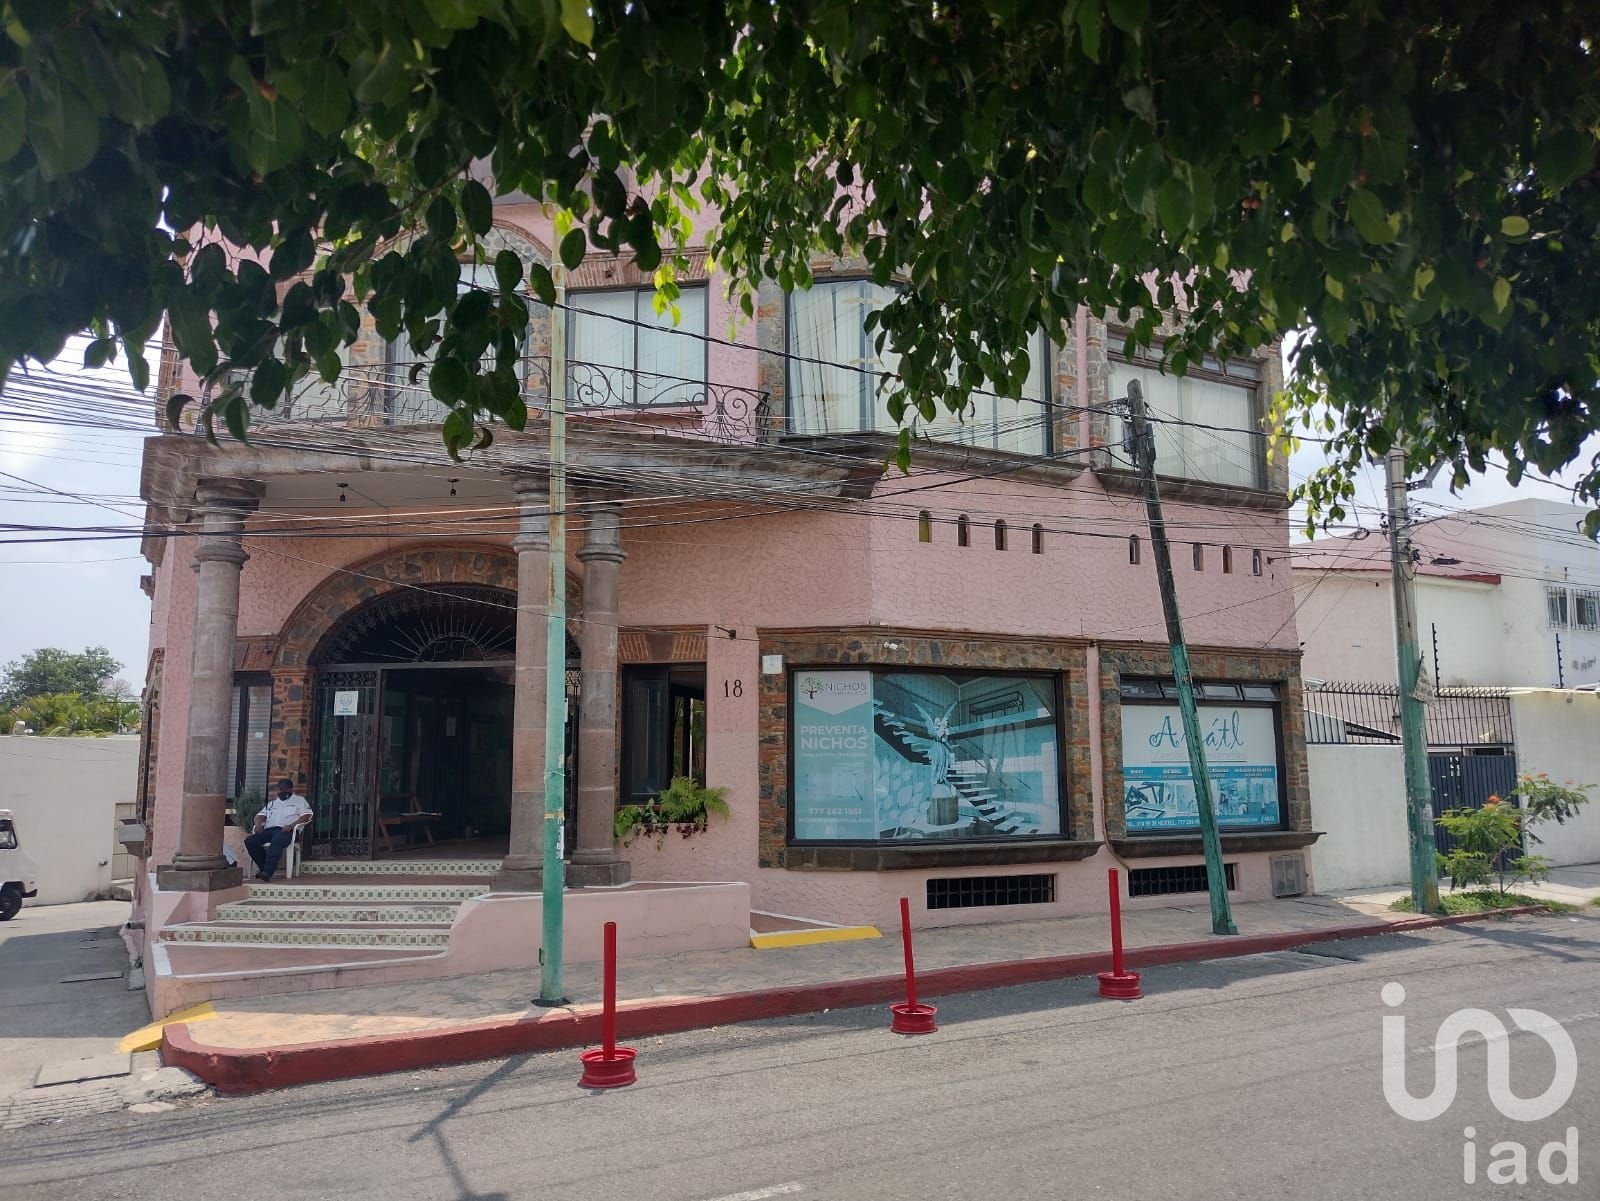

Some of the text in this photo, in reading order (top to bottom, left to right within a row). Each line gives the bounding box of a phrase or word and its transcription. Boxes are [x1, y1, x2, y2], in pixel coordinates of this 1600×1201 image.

[724, 679, 743, 698] 18
[825, 682, 867, 692] NICHOS
[801, 725, 867, 735] PREVENTA
[801, 737, 868, 749] NICHOS
